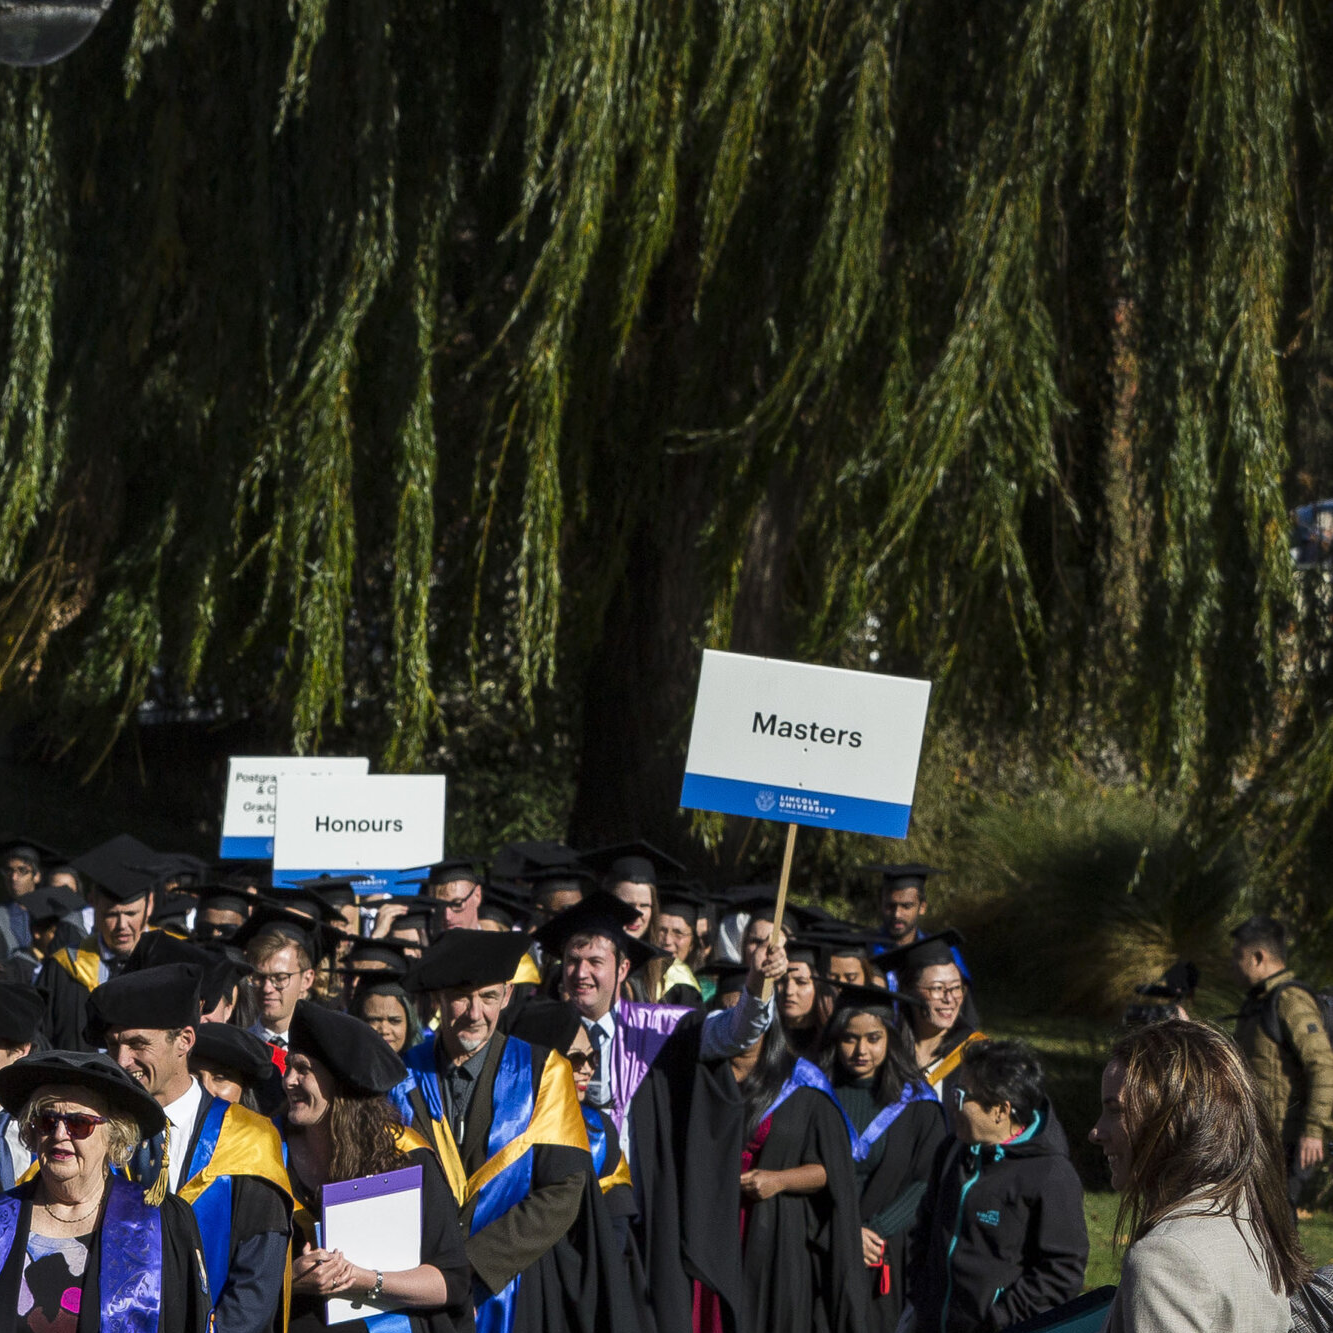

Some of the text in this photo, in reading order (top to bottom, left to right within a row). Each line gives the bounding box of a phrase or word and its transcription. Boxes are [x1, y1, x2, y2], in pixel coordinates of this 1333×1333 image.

[752, 711, 862, 748] Masters
[779, 794, 820, 806] LINCOLN
[778, 801, 836, 815] UNIVERSITY
[315, 815, 403, 832] Honours
